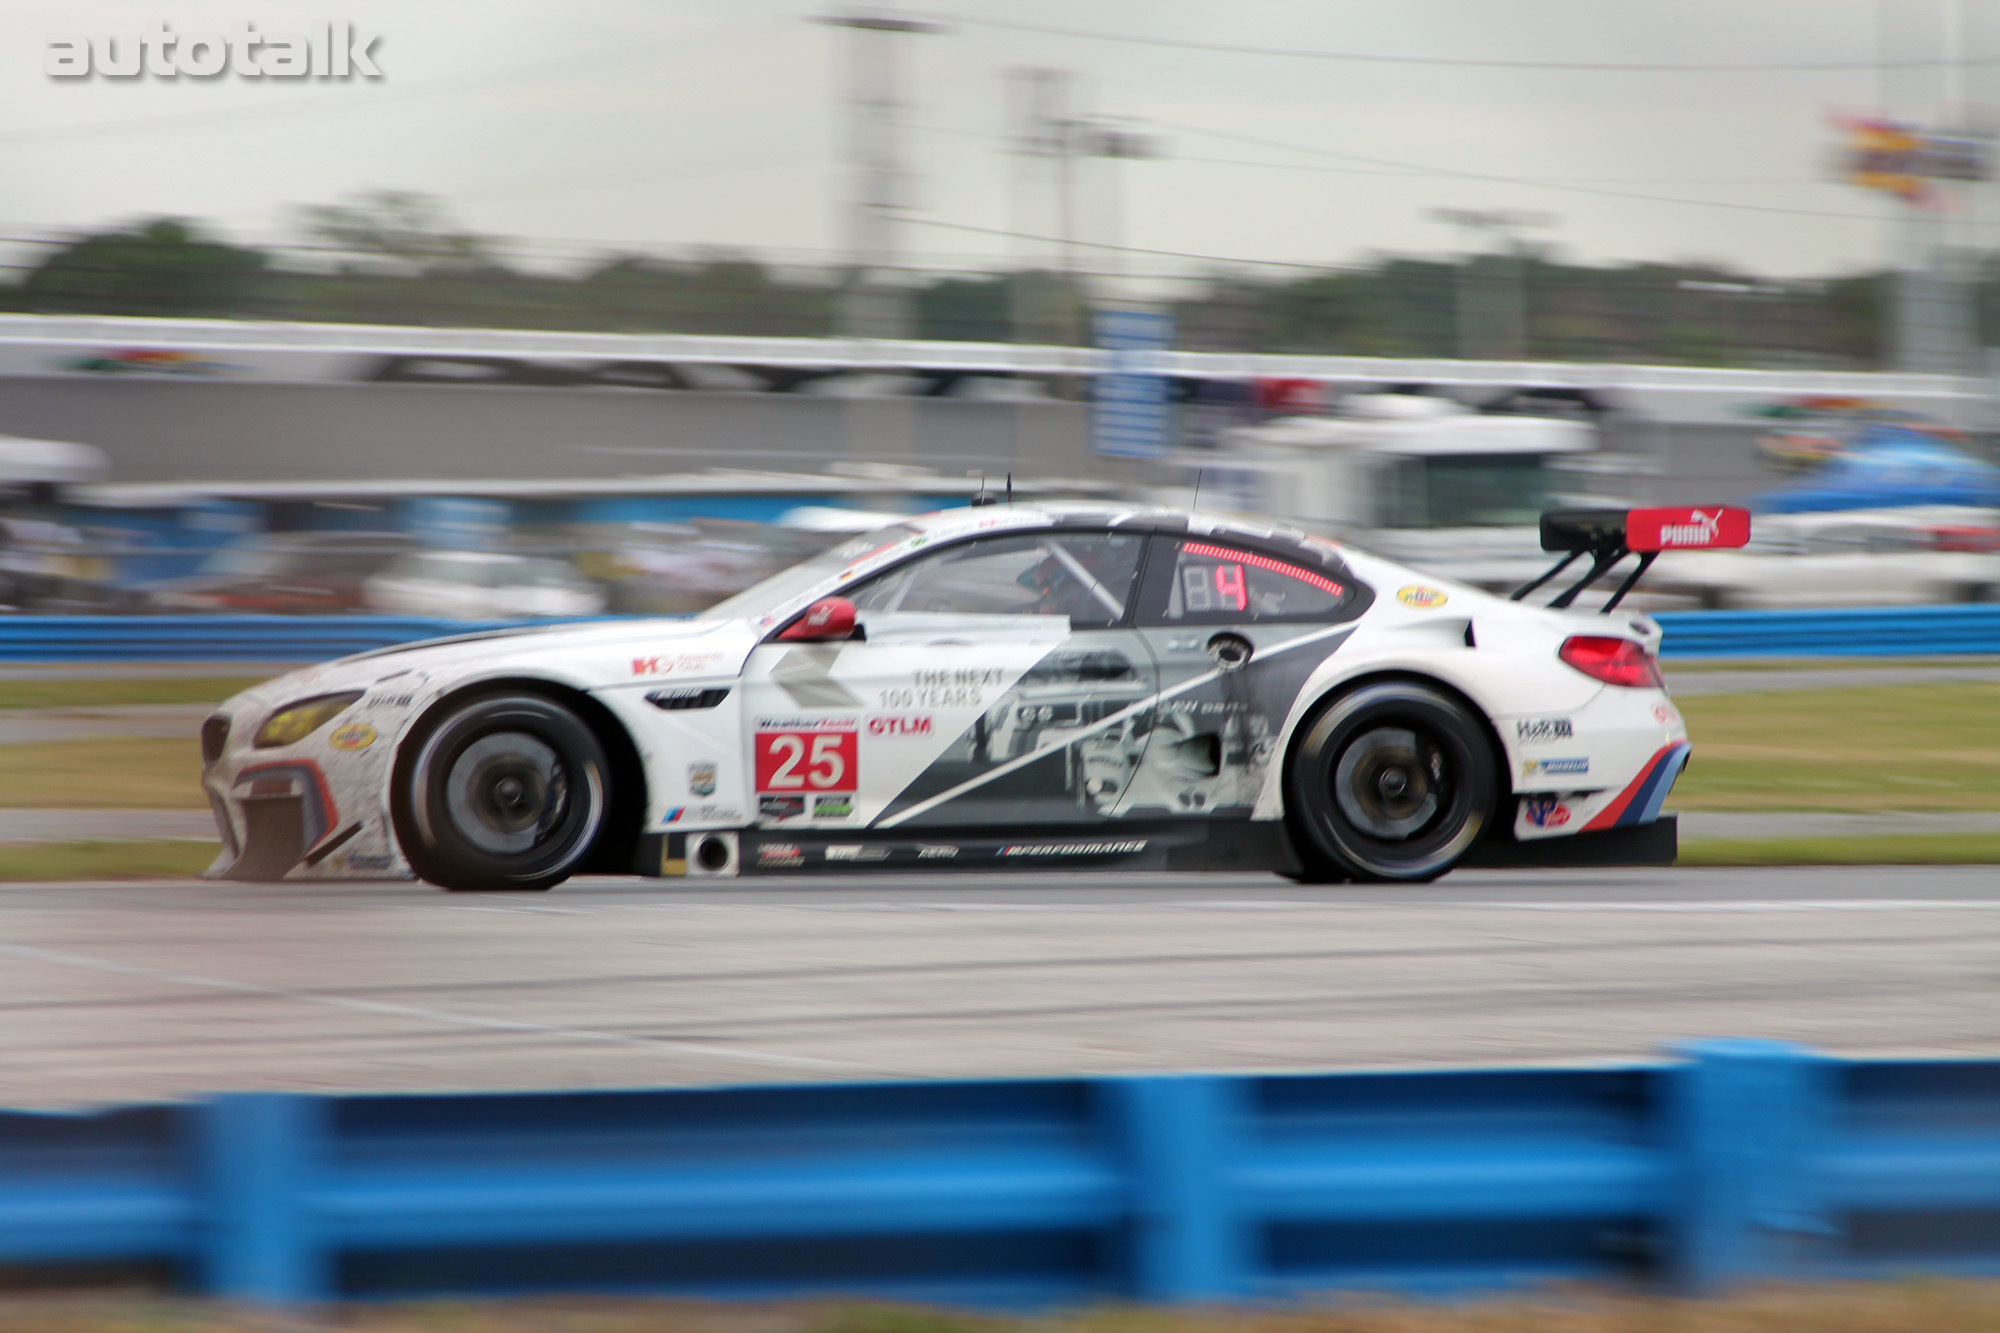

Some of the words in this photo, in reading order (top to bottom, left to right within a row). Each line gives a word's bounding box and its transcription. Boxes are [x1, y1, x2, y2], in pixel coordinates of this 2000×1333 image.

[1659, 524, 1711, 546] PUMA
[1215, 564, 1247, 611] 4
[913, 667, 951, 687] THE
[954, 667, 1006, 686] NEXT
[878, 688, 914, 709] 100
[916, 687, 983, 708] YEARS
[757, 716, 857, 731] WeatherTech
[868, 715, 933, 736] GTLM
[767, 734, 846, 789] 25
